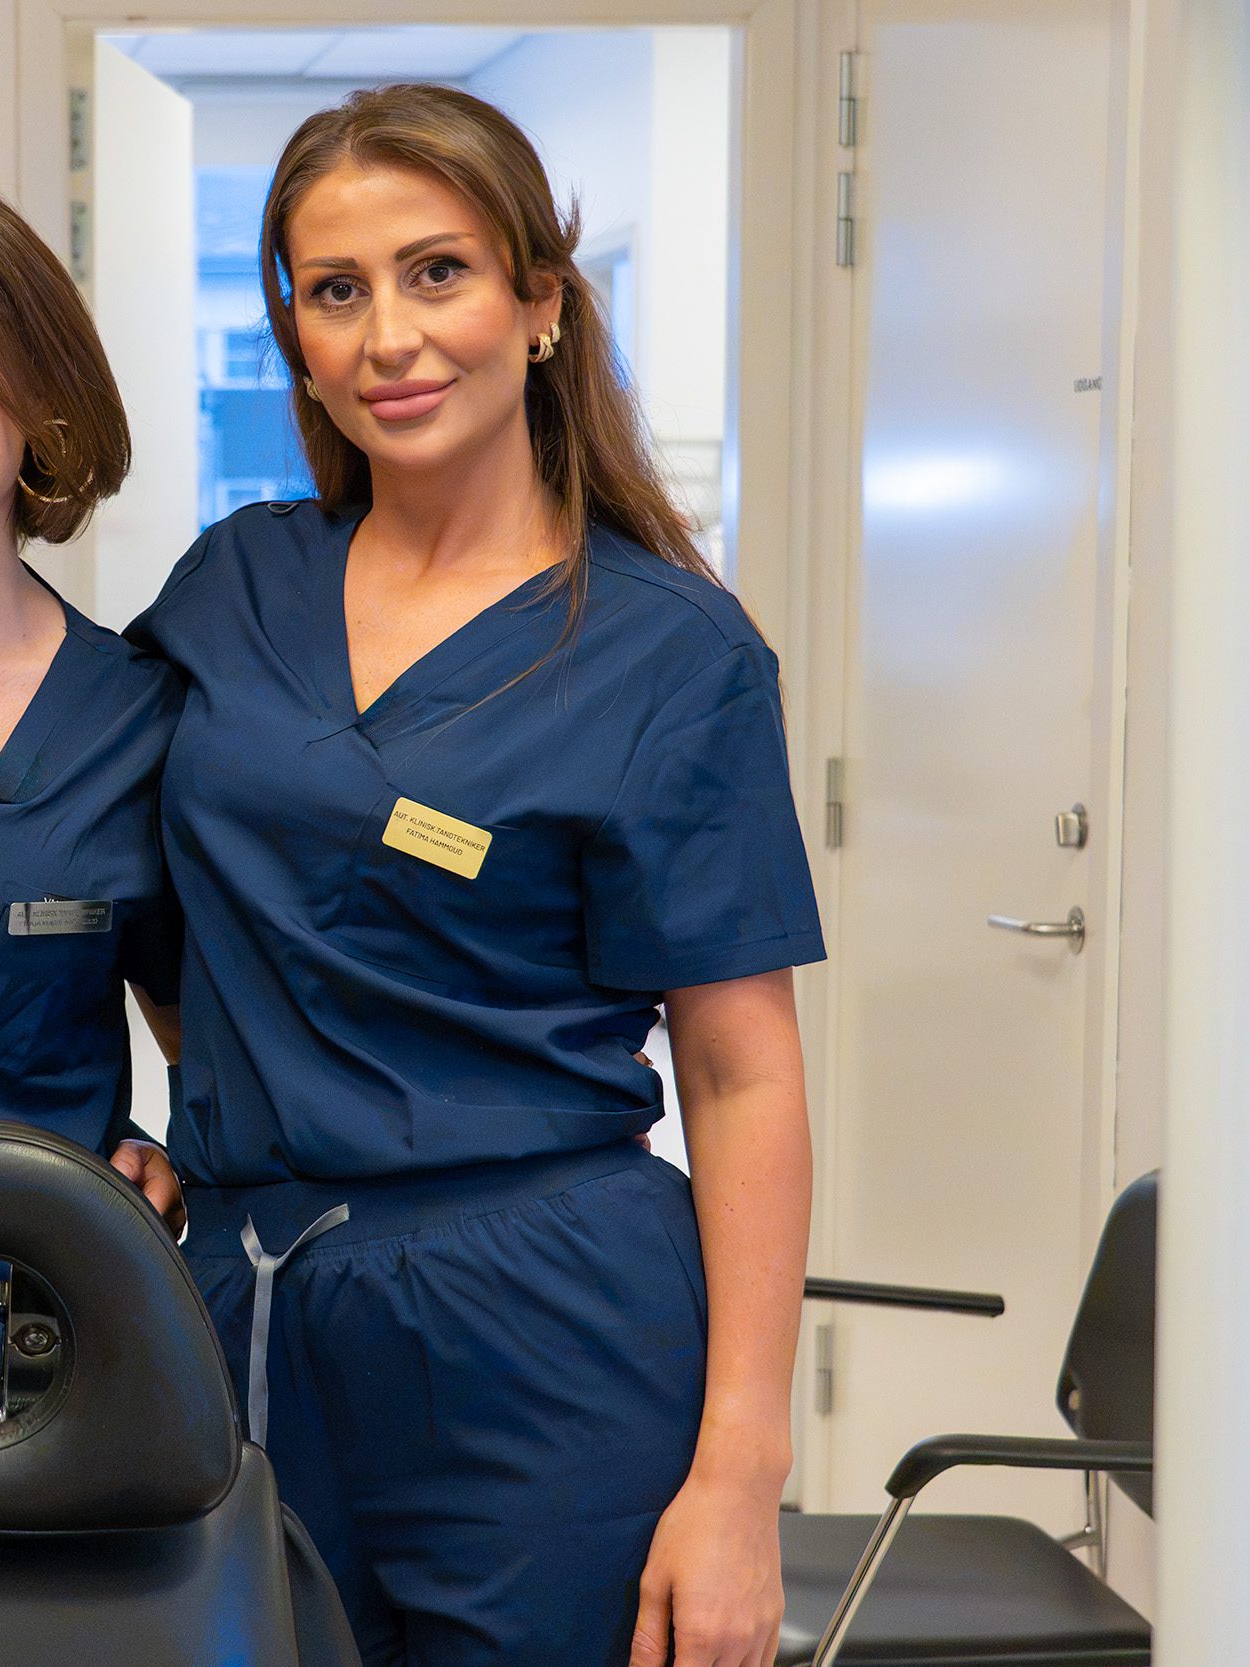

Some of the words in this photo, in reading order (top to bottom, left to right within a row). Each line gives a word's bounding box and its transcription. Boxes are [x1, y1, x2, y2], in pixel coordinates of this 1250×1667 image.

[393, 810, 409, 822] AUT.
[409, 817, 436, 833] KLINISK
[436, 827, 486, 852] TANDTEKNIKER
[405, 828, 430, 843] FATIMA
[429, 838, 463, 856] HAMMOUD
